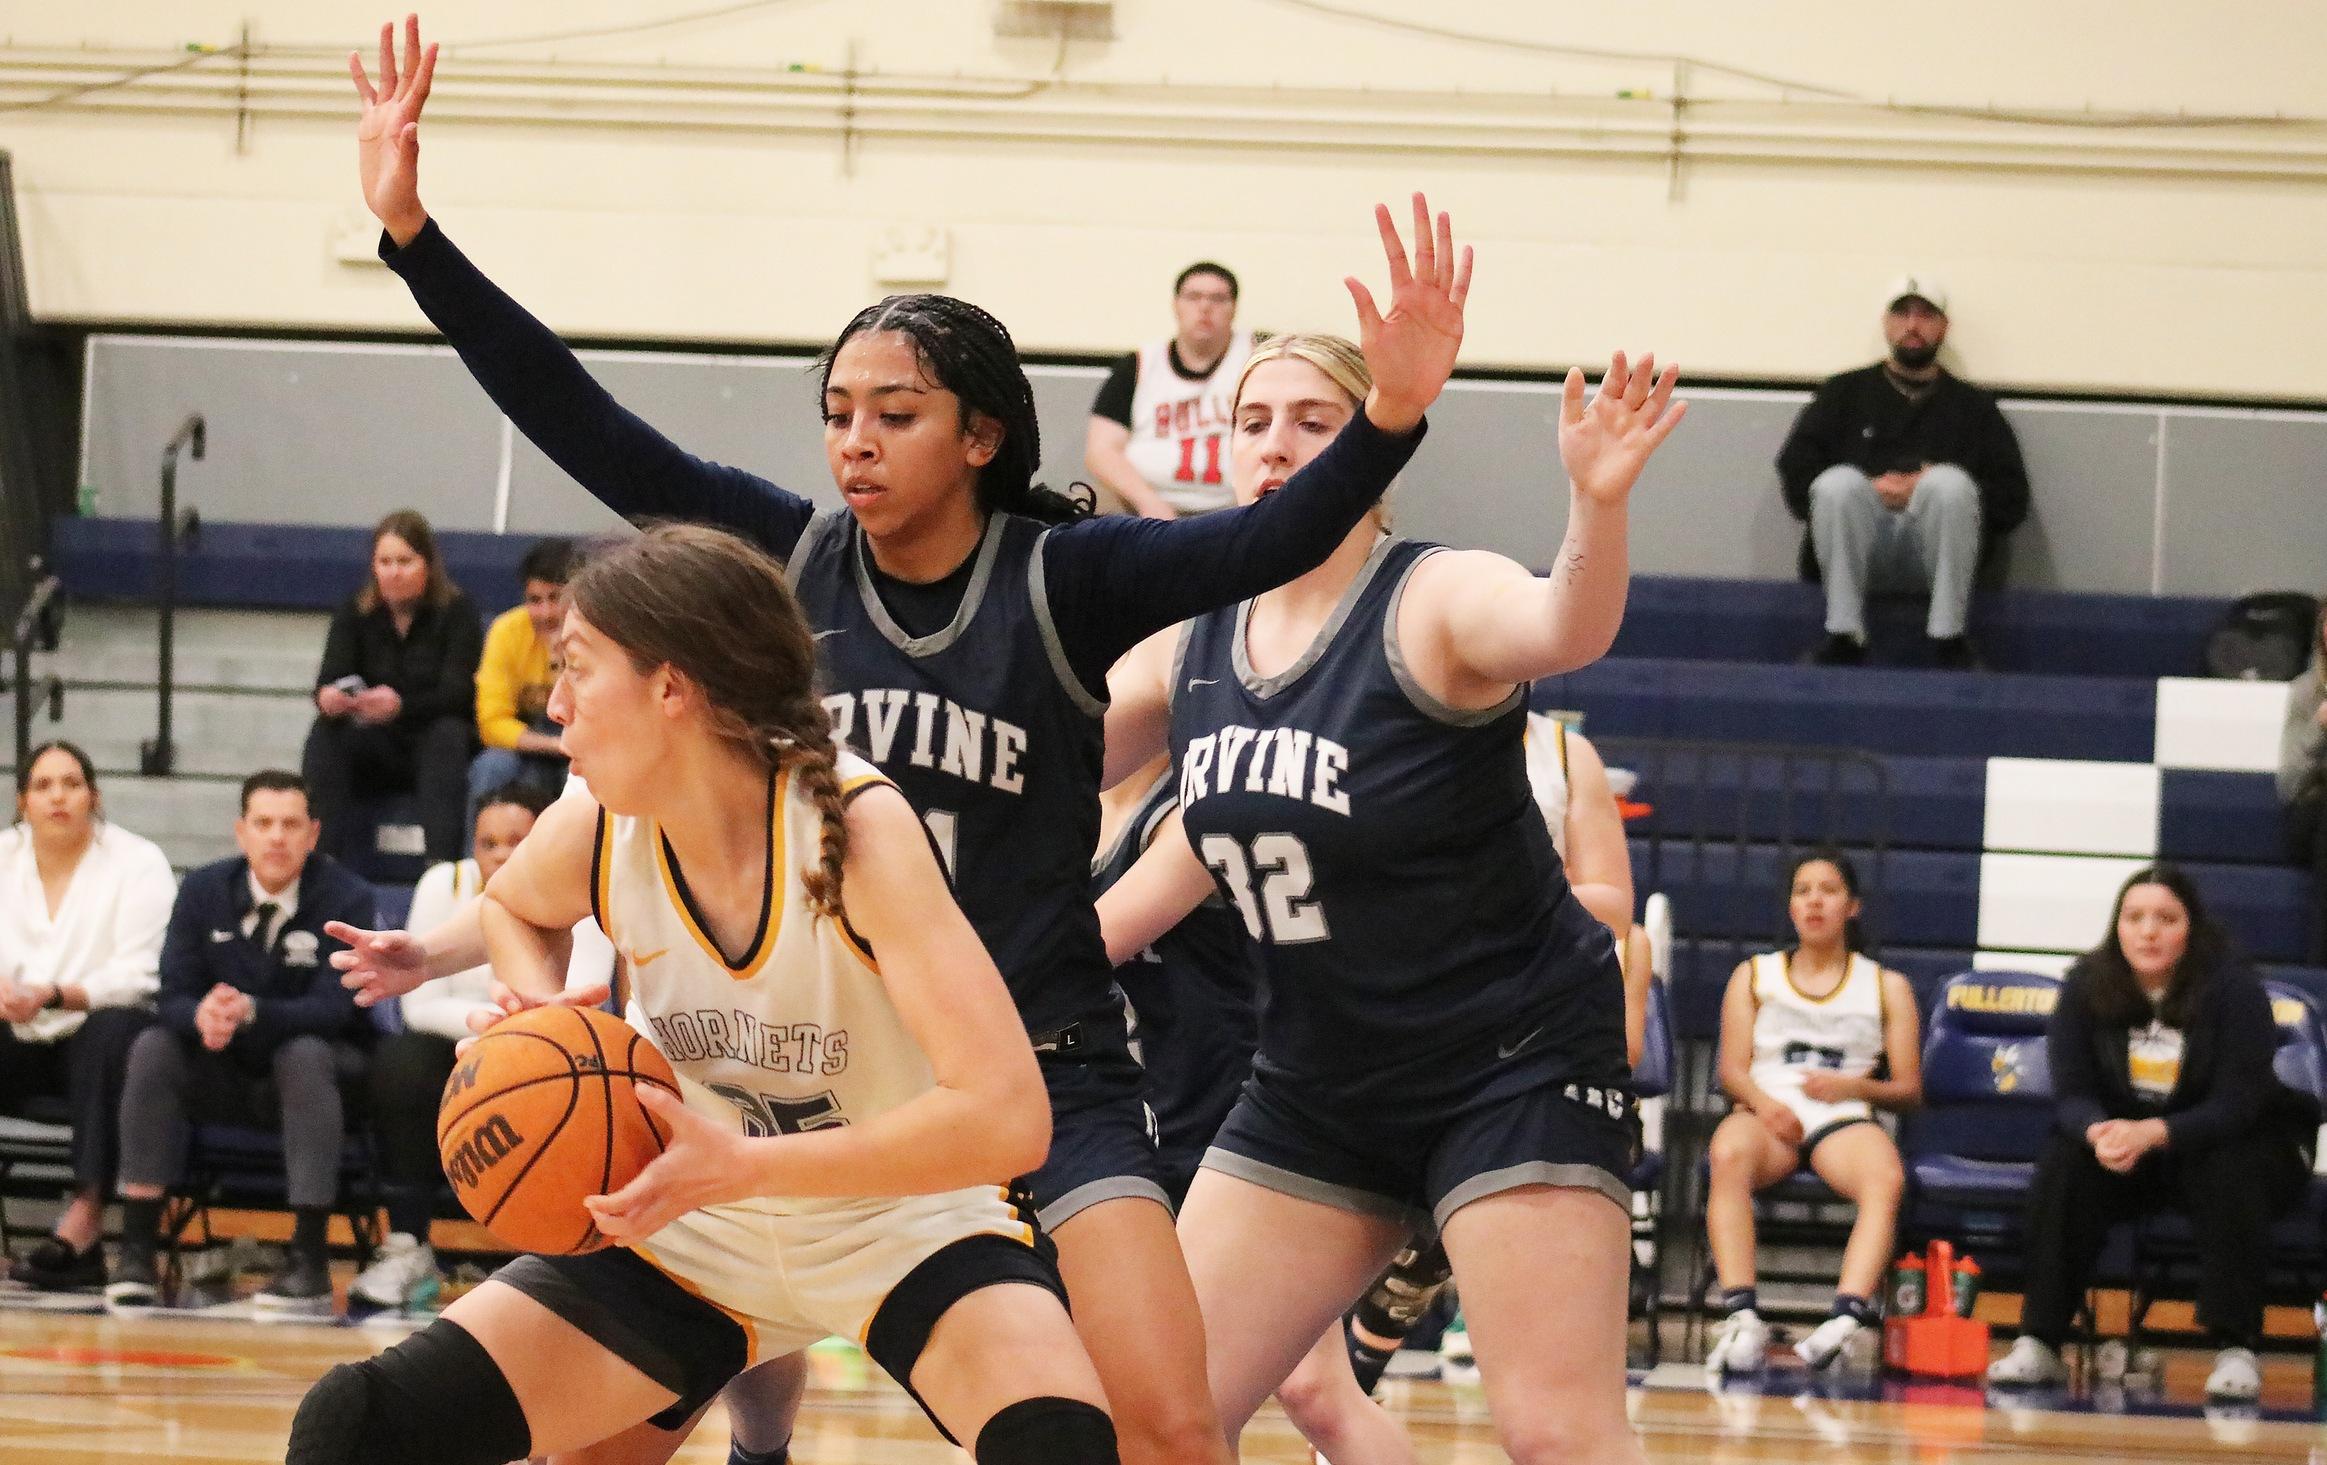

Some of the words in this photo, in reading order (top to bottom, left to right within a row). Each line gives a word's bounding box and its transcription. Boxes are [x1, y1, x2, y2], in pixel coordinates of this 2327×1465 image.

[1154, 394, 1234, 438] BULL
[1174, 434, 1222, 484] 11
[820, 688, 1028, 795] RVINE
[1200, 832, 1332, 945] 32
[1945, 985, 2059, 1016] FULLERTO
[650, 1009, 849, 1076] HORNETS
[1067, 1034, 1075, 1045] L
